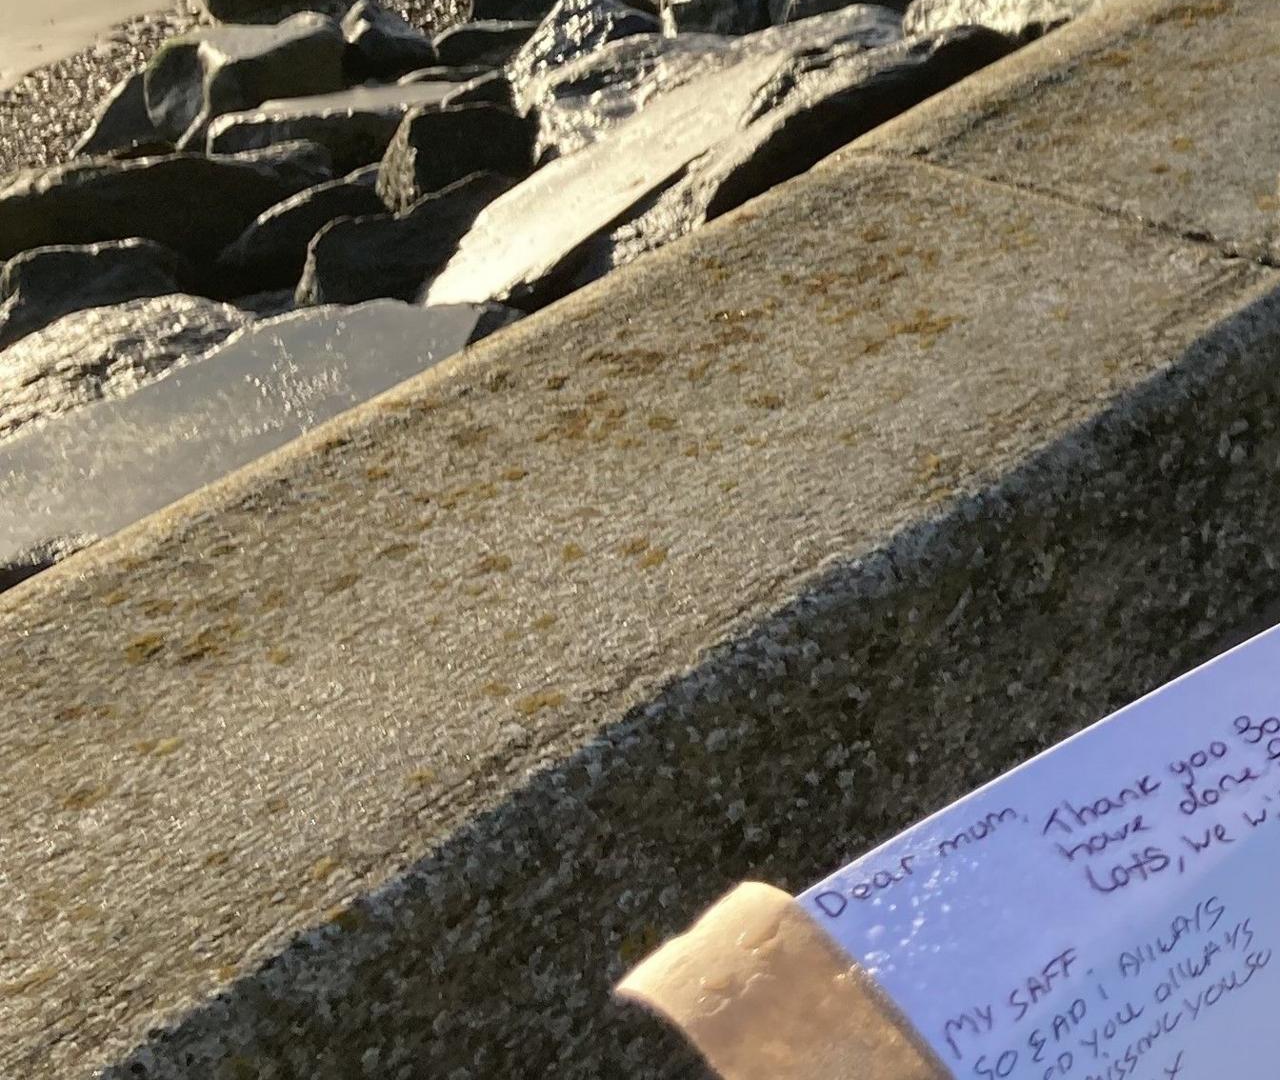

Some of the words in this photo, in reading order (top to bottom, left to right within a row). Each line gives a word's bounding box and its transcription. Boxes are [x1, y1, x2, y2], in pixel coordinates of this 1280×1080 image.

[1042, 775, 1162, 836] Thank
[1055, 815, 1151, 862] have
[1179, 768, 1261, 816] done
[1181, 823, 1237, 853] we
[814, 855, 917, 919] Dear
[1008, 947, 1078, 1022] SAFF
